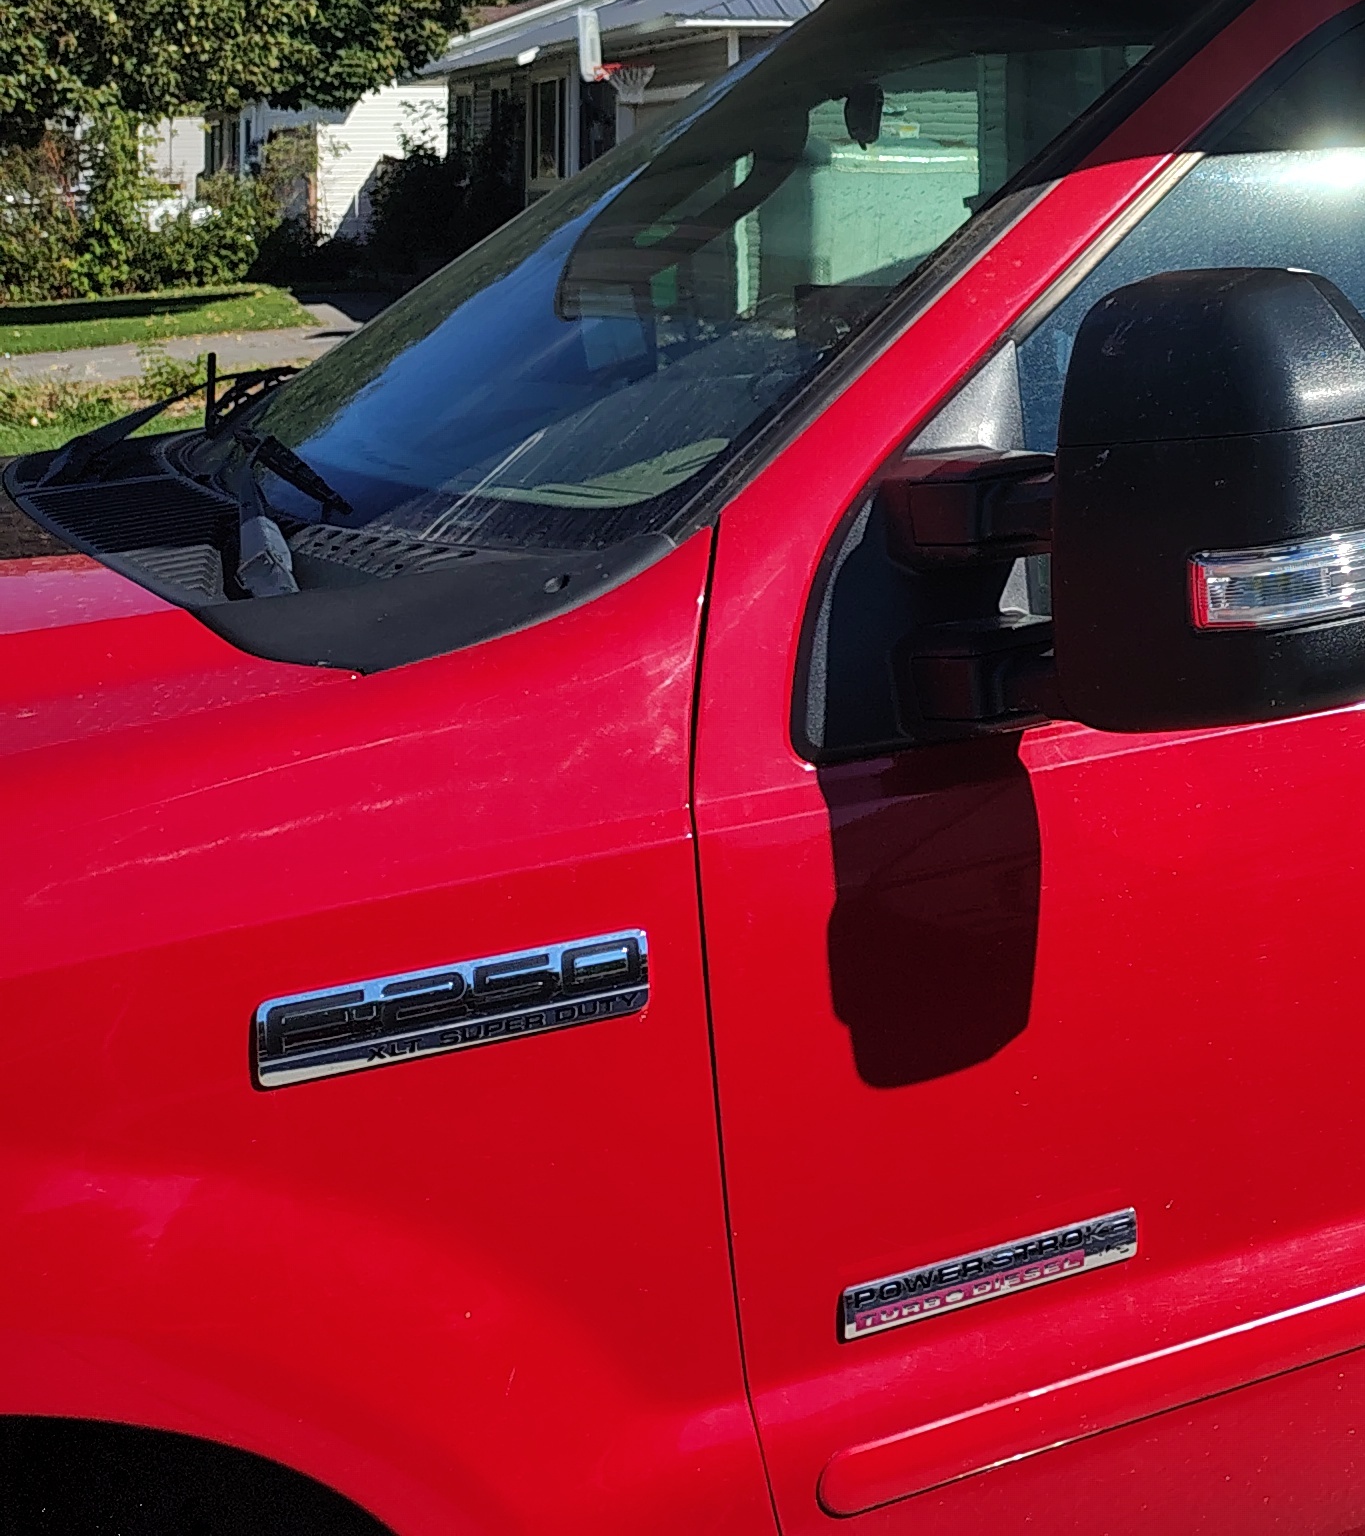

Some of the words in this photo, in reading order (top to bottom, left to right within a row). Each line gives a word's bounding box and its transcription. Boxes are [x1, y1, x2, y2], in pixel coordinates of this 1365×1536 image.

[366, 1038, 422, 1063] XLT
[439, 1014, 547, 1045] SUPER
[555, 992, 640, 1022] DUTY
[853, 1257, 985, 1309] POWER
[859, 1289, 966, 1327] TURBO
[972, 1257, 1082, 1297] DIESEL
